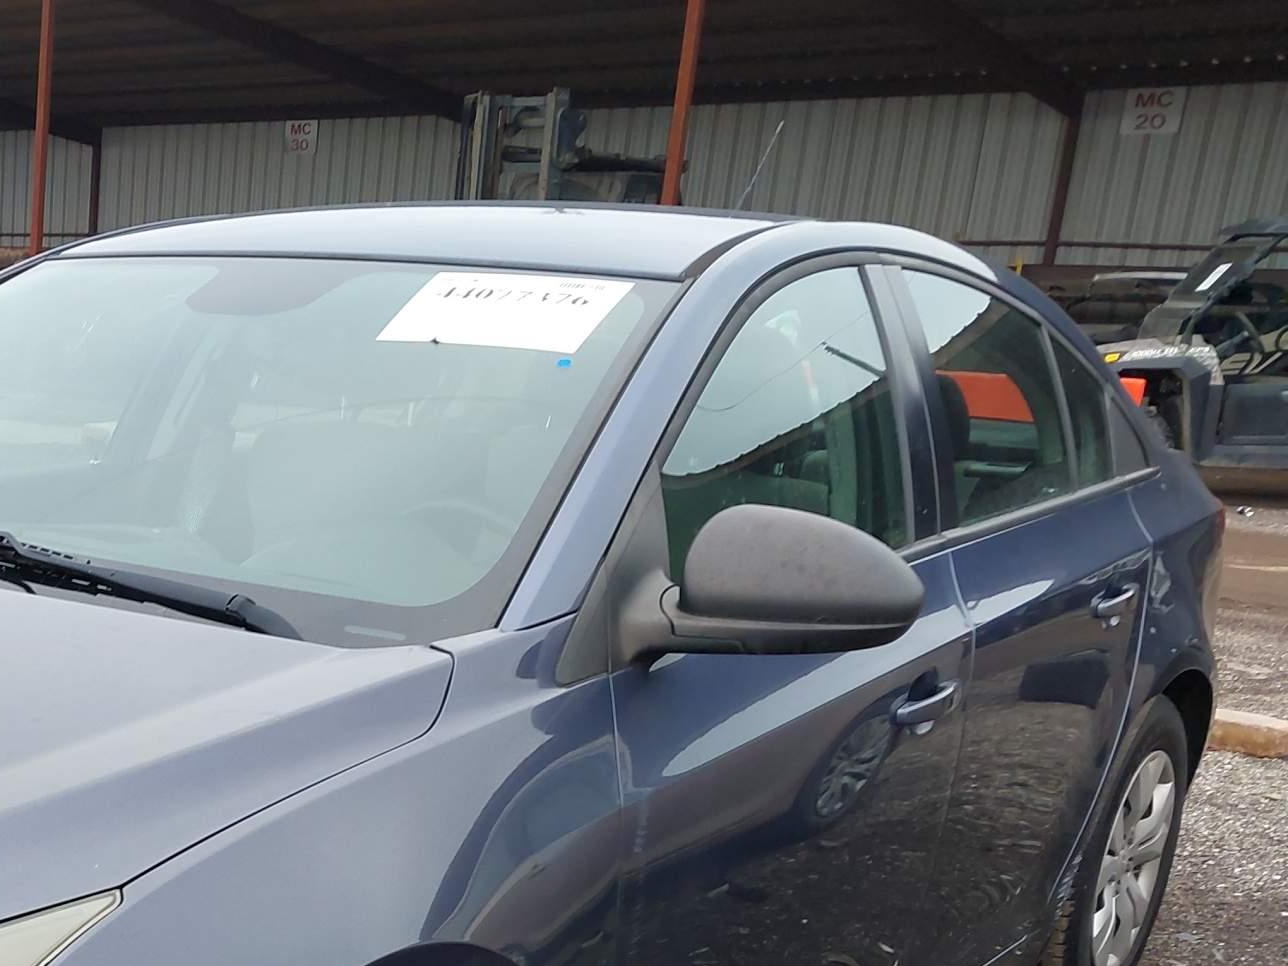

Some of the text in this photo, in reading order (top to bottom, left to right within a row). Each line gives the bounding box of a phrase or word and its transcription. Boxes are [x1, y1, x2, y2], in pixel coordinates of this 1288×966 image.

[1134, 90, 1175, 109] MC
[290, 122, 312, 136] MC
[1134, 112, 1167, 130] 20
